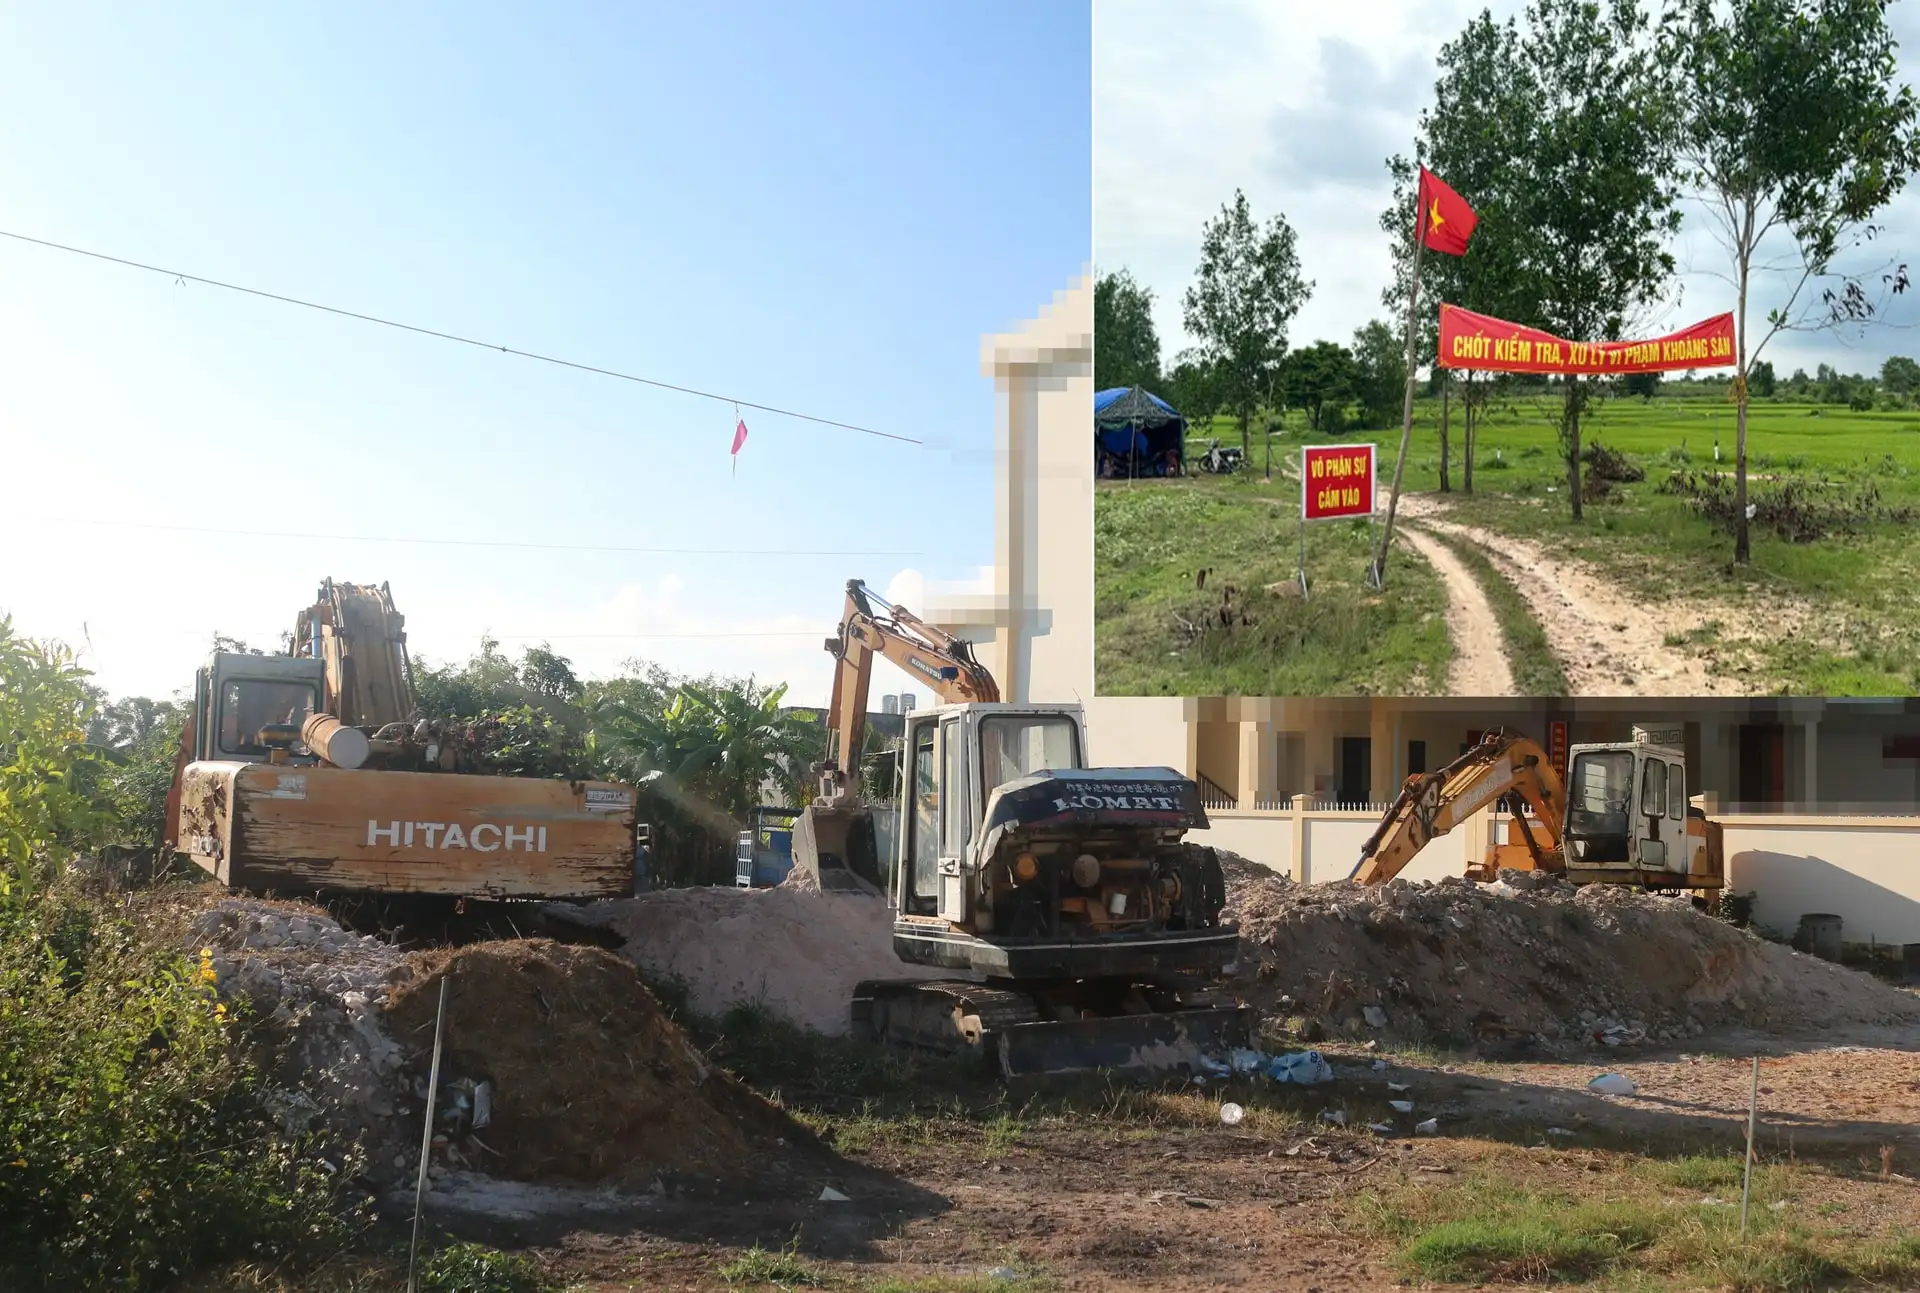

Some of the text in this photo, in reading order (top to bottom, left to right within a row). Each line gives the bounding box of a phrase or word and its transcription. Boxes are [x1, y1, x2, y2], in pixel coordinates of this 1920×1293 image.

[1453, 330, 1491, 359] CHỐT
[1495, 331, 1531, 361] KIỂM
[1535, 342, 1565, 367] TRA,
[1608, 349, 1622, 366] VI
[1624, 342, 1660, 368] PHẠM
[1663, 336, 1709, 362] KHOÁNG
[1711, 330, 1731, 357] SẢN
[1311, 454, 1367, 480] VÔ PHẬN SỰ
[1318, 483, 1360, 509] CẤM VÀO
[367, 819, 547, 852] HITACHI
